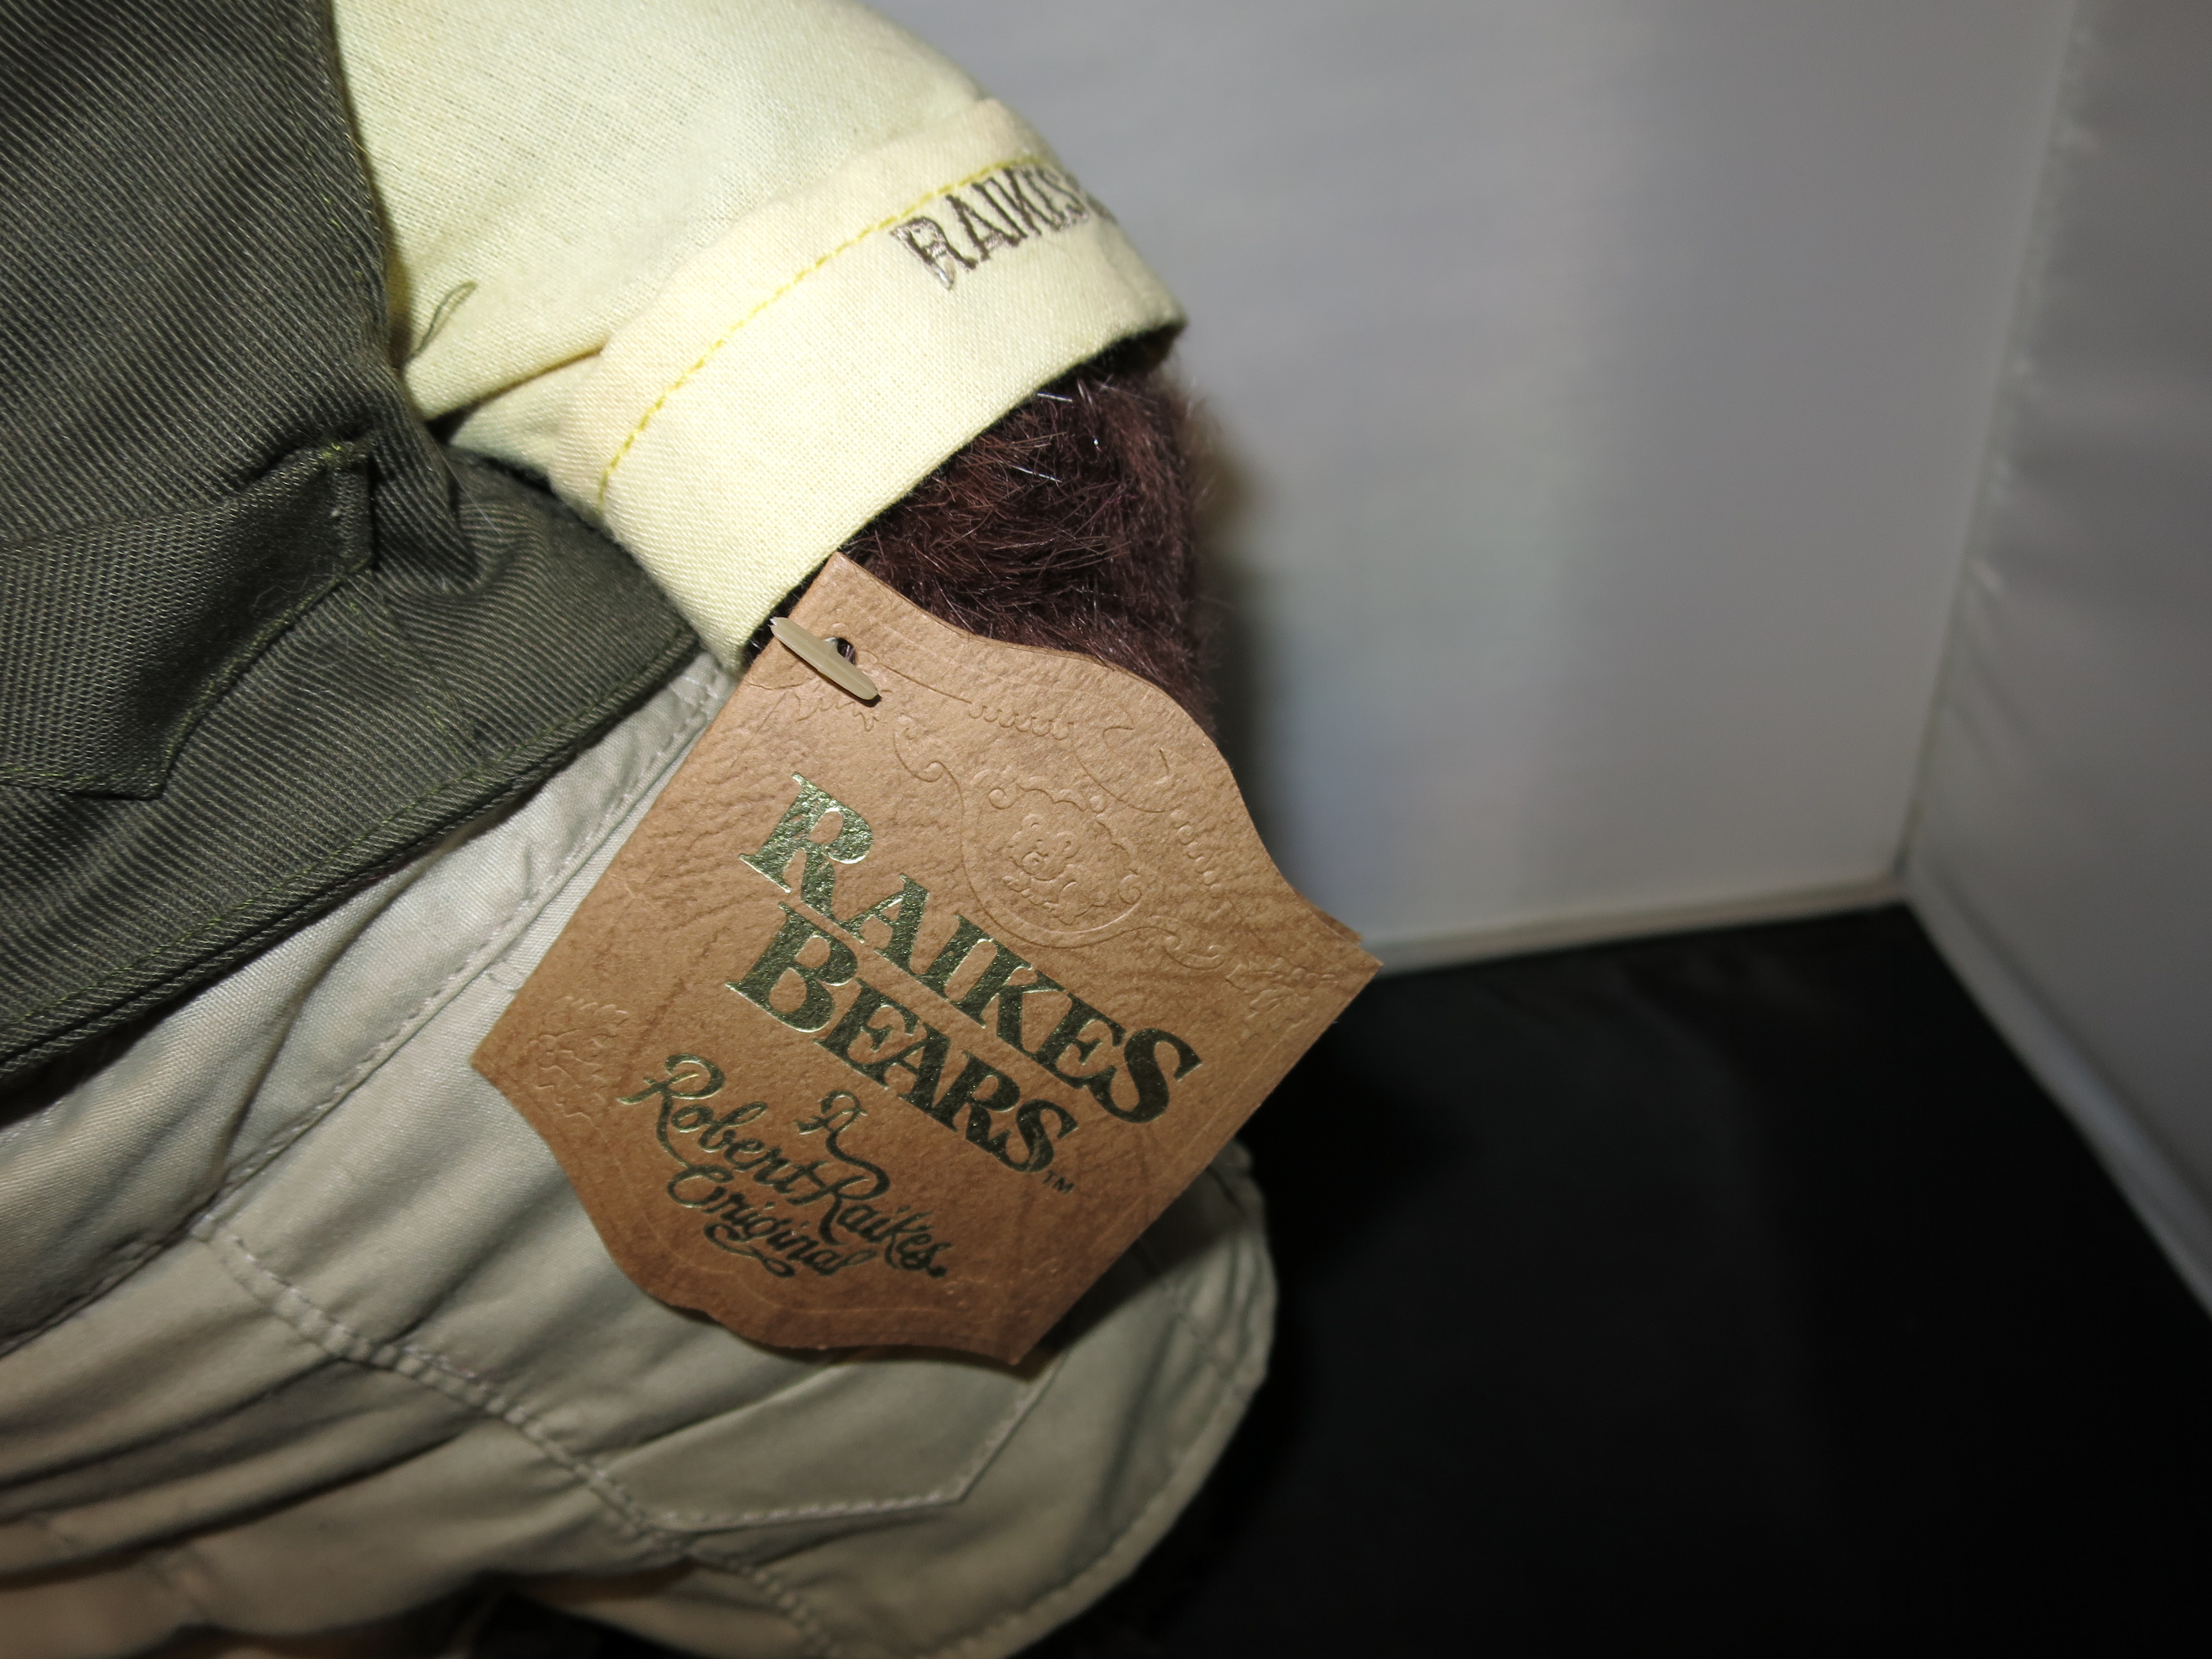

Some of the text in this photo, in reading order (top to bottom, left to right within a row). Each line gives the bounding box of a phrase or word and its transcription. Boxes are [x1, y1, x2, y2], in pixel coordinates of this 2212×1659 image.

[726, 902, 1078, 1172] BEARS
[738, 772, 1202, 1124] RAIKES
[615, 1053, 830, 1194] Robert
[667, 1164, 878, 1277] Original
